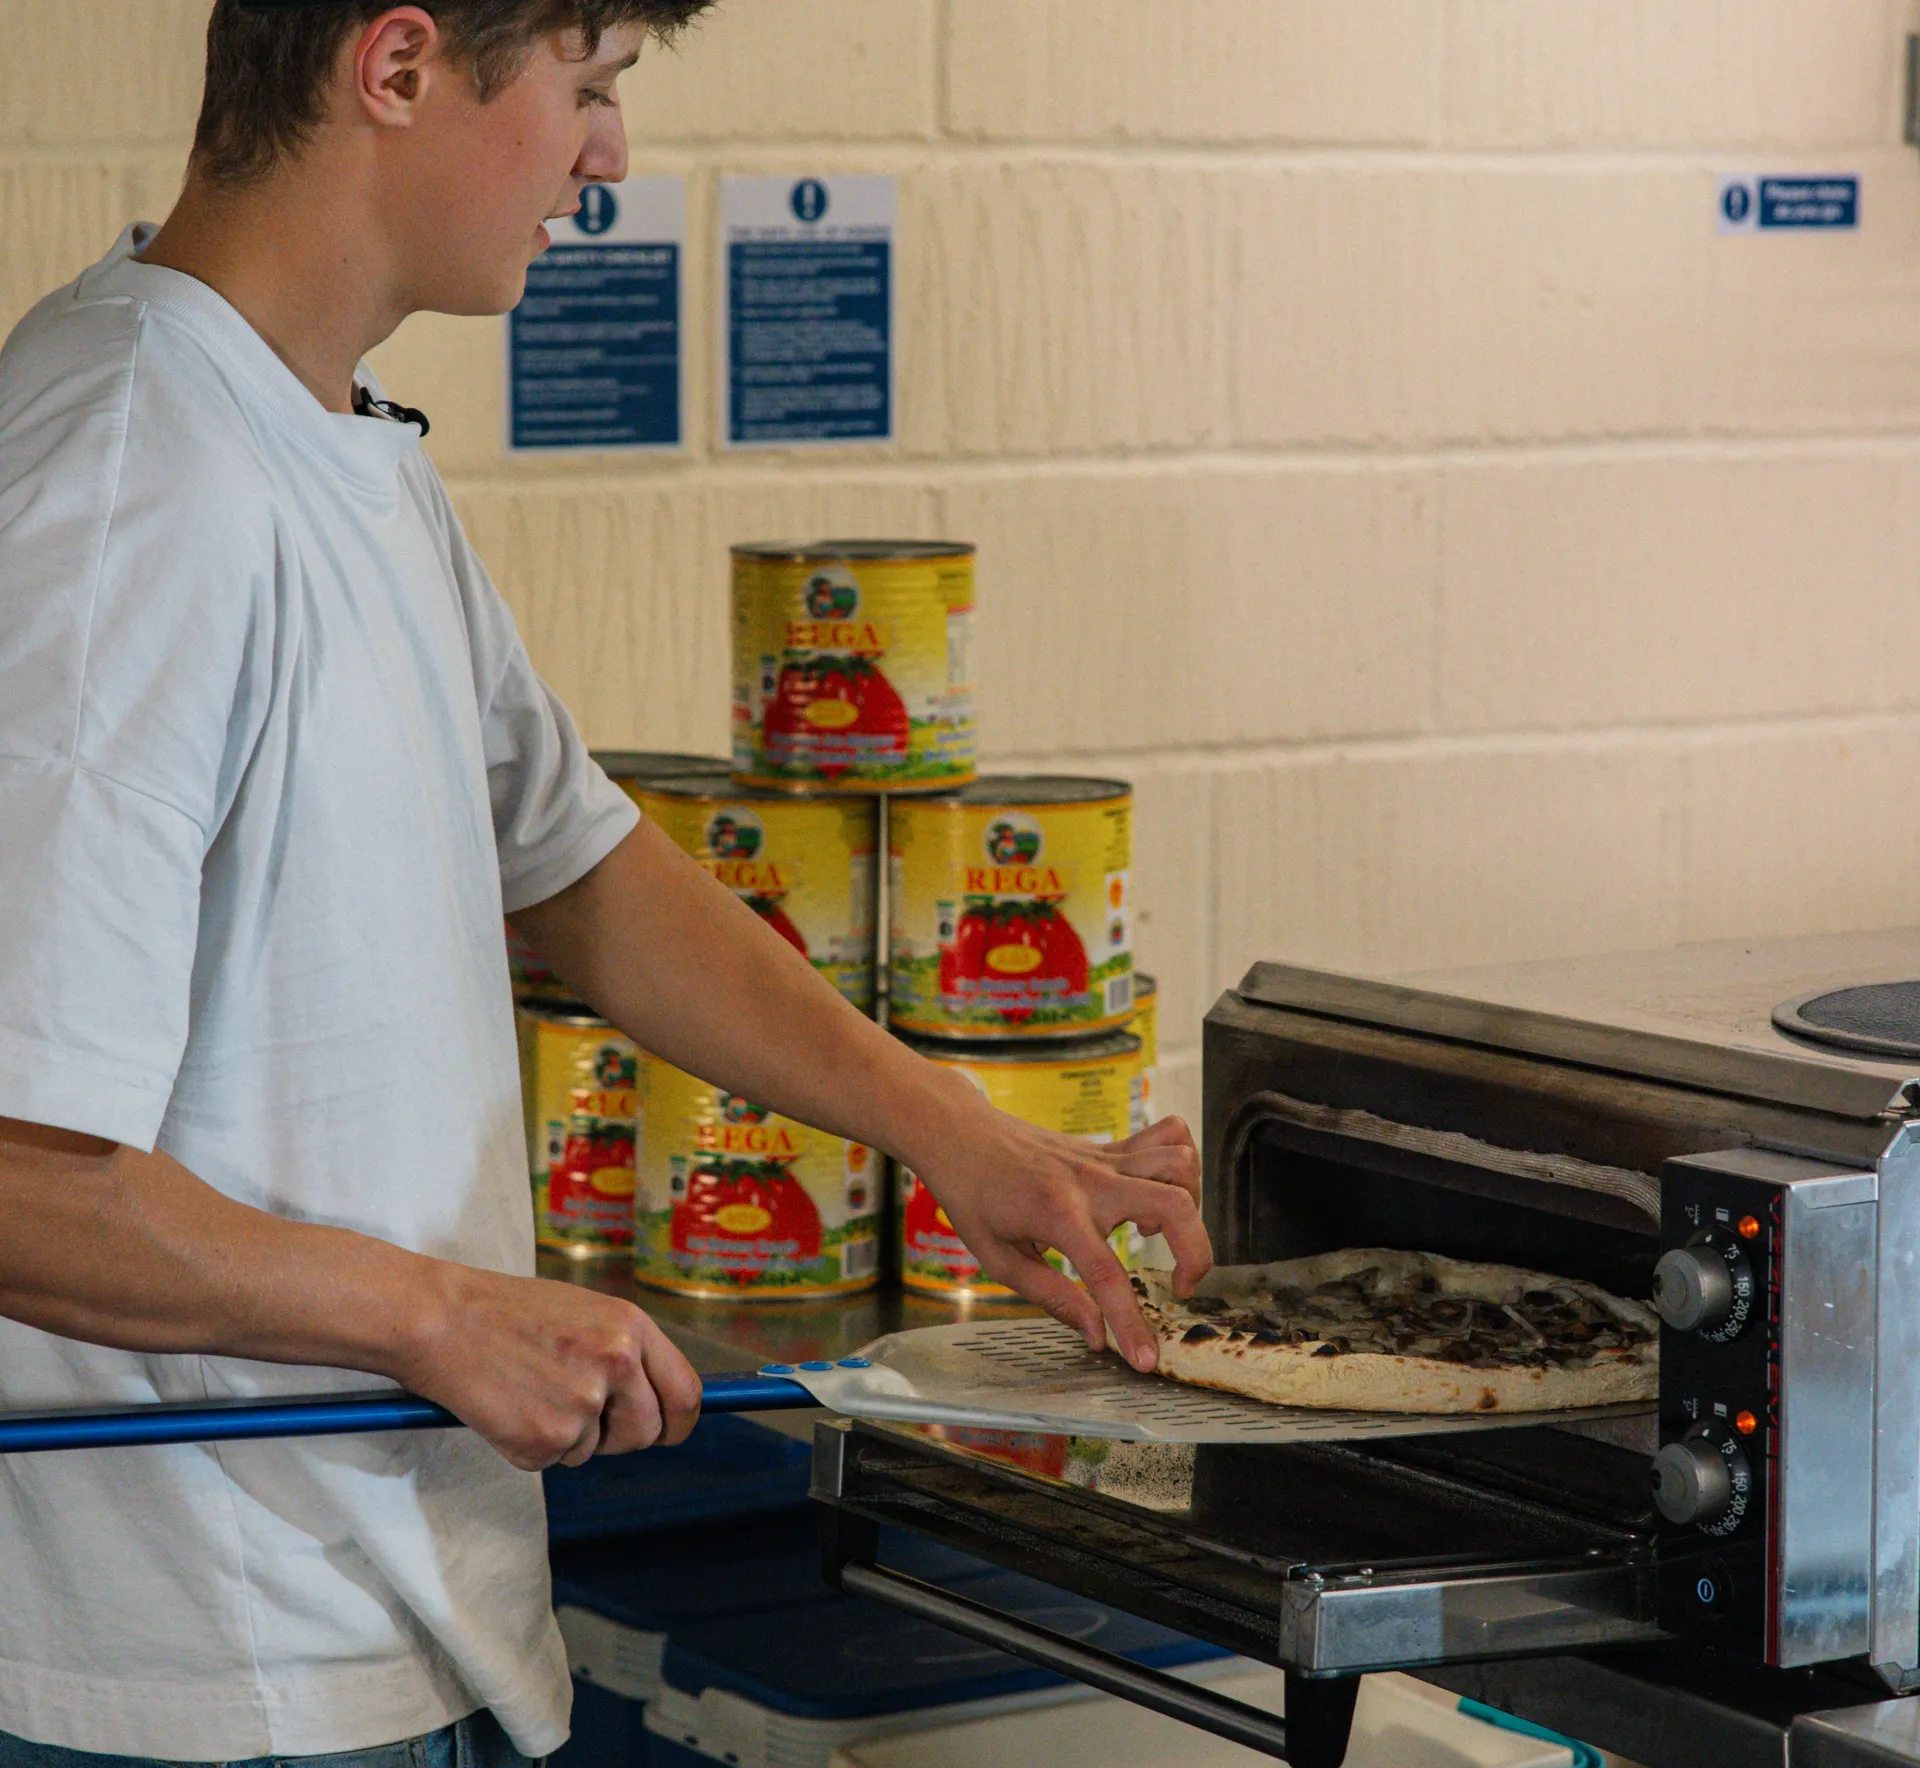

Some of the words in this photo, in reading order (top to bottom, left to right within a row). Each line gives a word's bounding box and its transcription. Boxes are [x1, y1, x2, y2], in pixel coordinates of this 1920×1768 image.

[785, 621, 881, 648] REGA
[701, 863, 783, 887] EGA
[965, 865, 1062, 894] REGA
[697, 1125, 795, 1152] REGA
[1727, 1243, 1740, 1259] 75
[1737, 1275, 1749, 1297] 150
[1734, 1299, 1750, 1321] 200
[1722, 1438, 1737, 1455] 75
[1735, 1470, 1748, 1492] 150
[1732, 1496, 1748, 1516] 200
